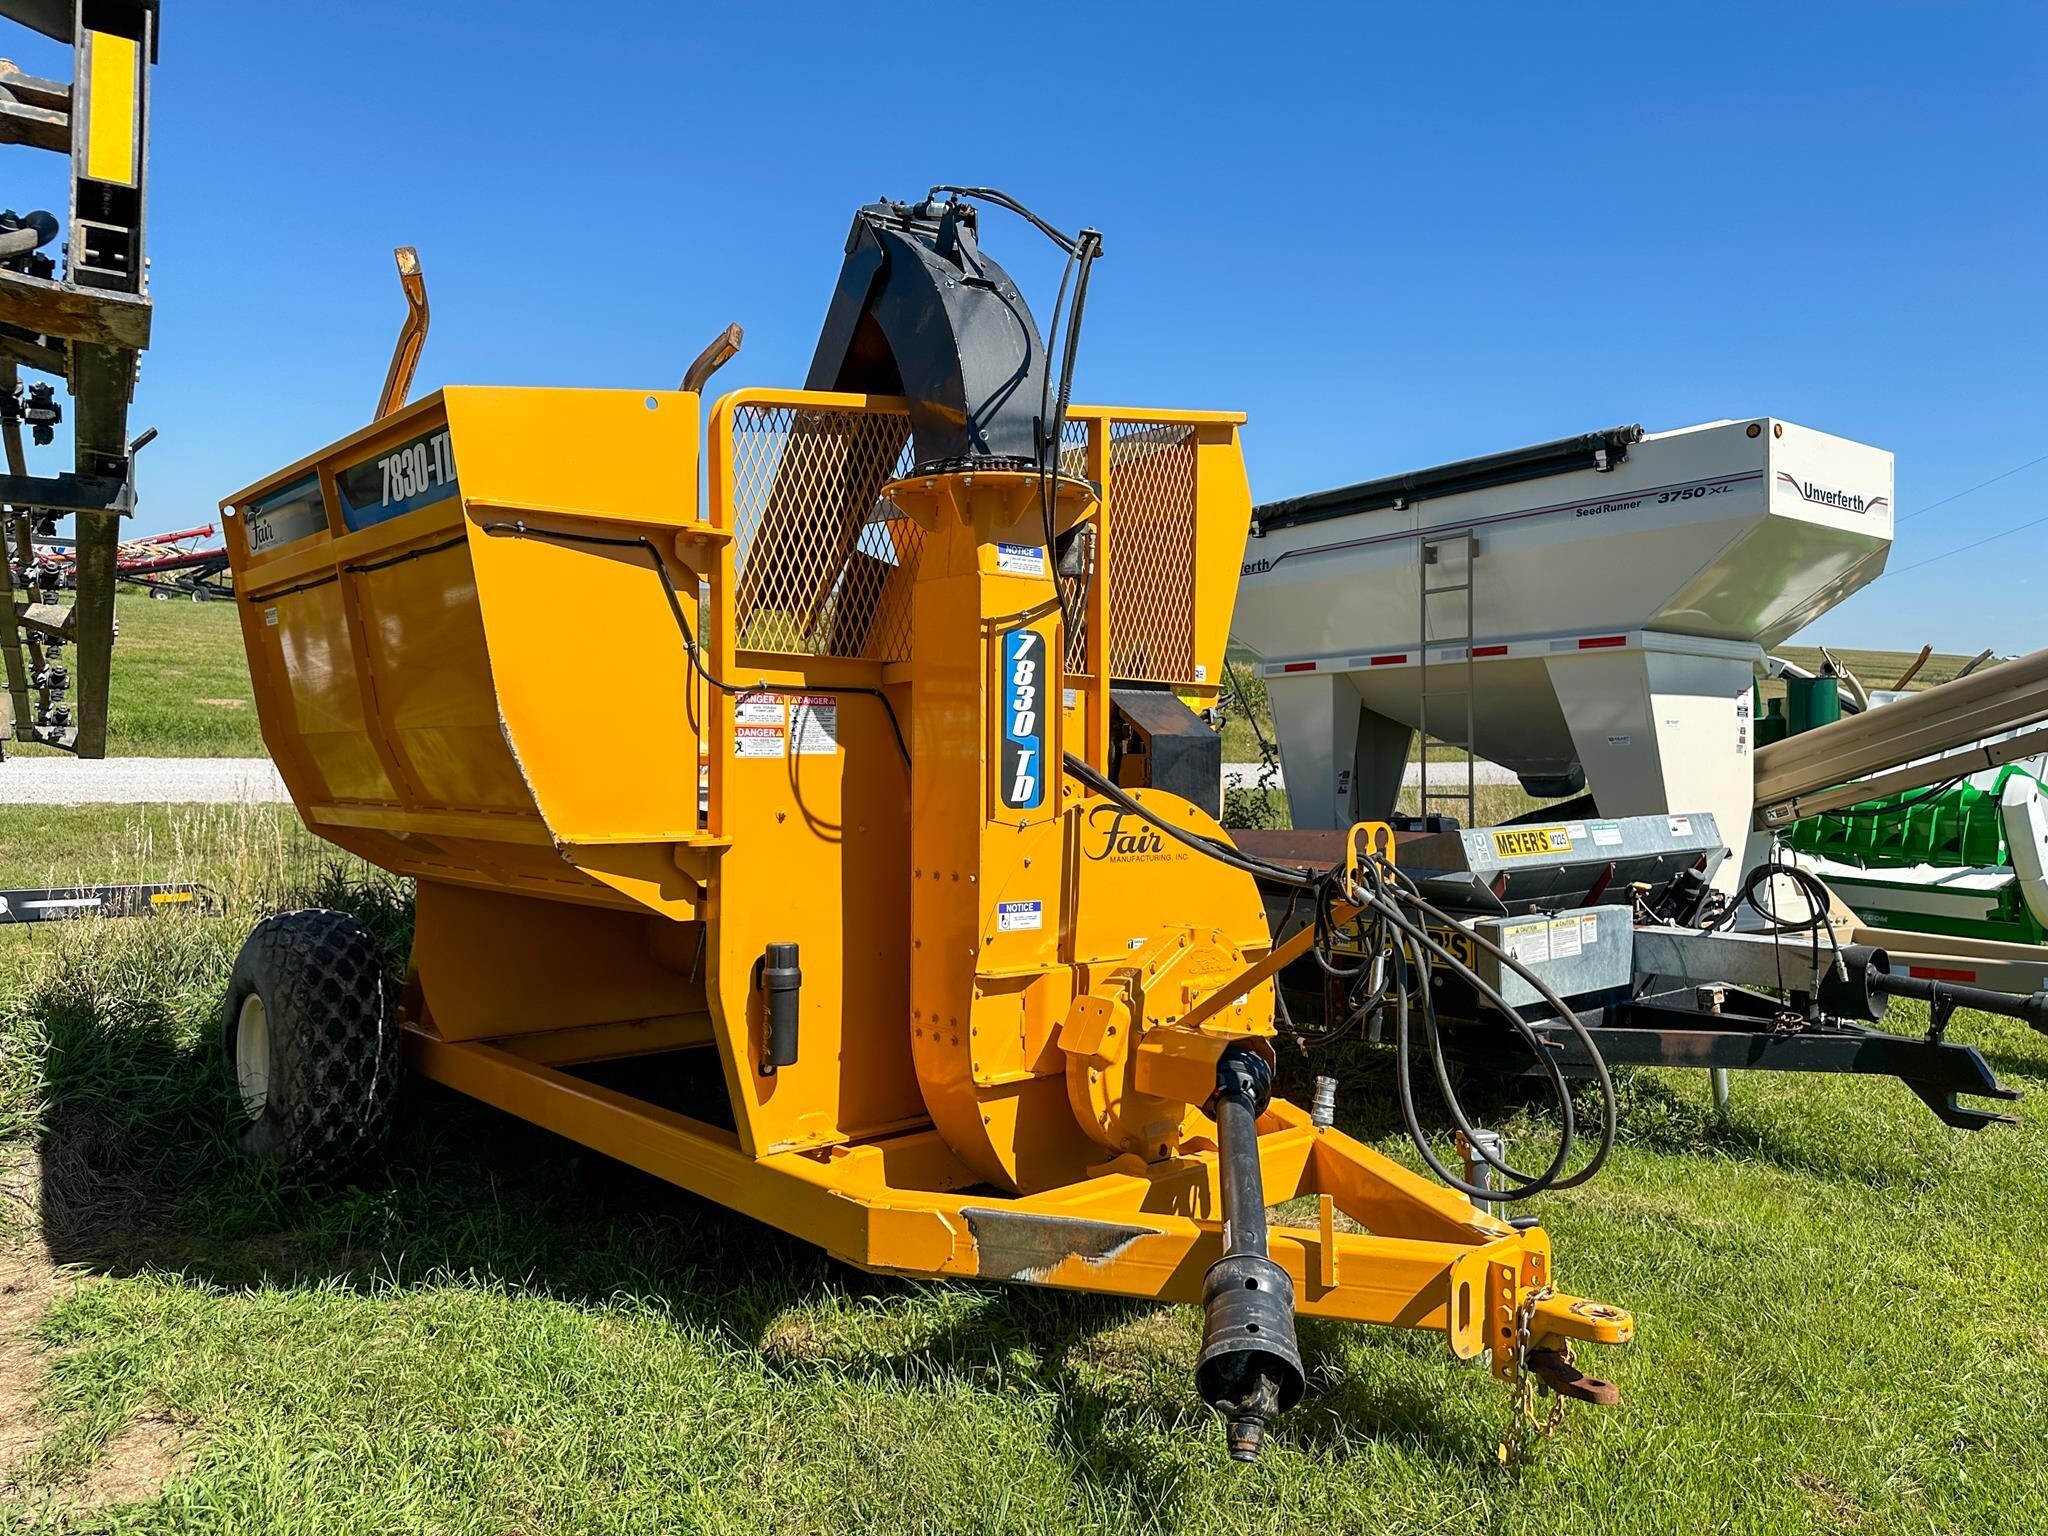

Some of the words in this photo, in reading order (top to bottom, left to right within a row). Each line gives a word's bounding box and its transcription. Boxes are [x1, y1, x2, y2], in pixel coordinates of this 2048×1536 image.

[1658, 486, 1706, 504] 3750
[1708, 485, 1735, 496] XL
[1804, 481, 1864, 511] Unverferth
[246, 505, 274, 550] Fair
[1005, 544, 1035, 557] NOTICE
[1012, 634, 1037, 738] 7830
[738, 694, 776, 704] DANGER
[798, 696, 829, 705] DANGER
[738, 728, 776, 737] DANGER
[1010, 750, 1036, 802] TD
[1083, 804, 1165, 861] Fair
[1496, 831, 1549, 855] MEYER'S
[1110, 854, 1174, 864] MANUFACTURING,
[1006, 902, 1034, 913] NOTICE
